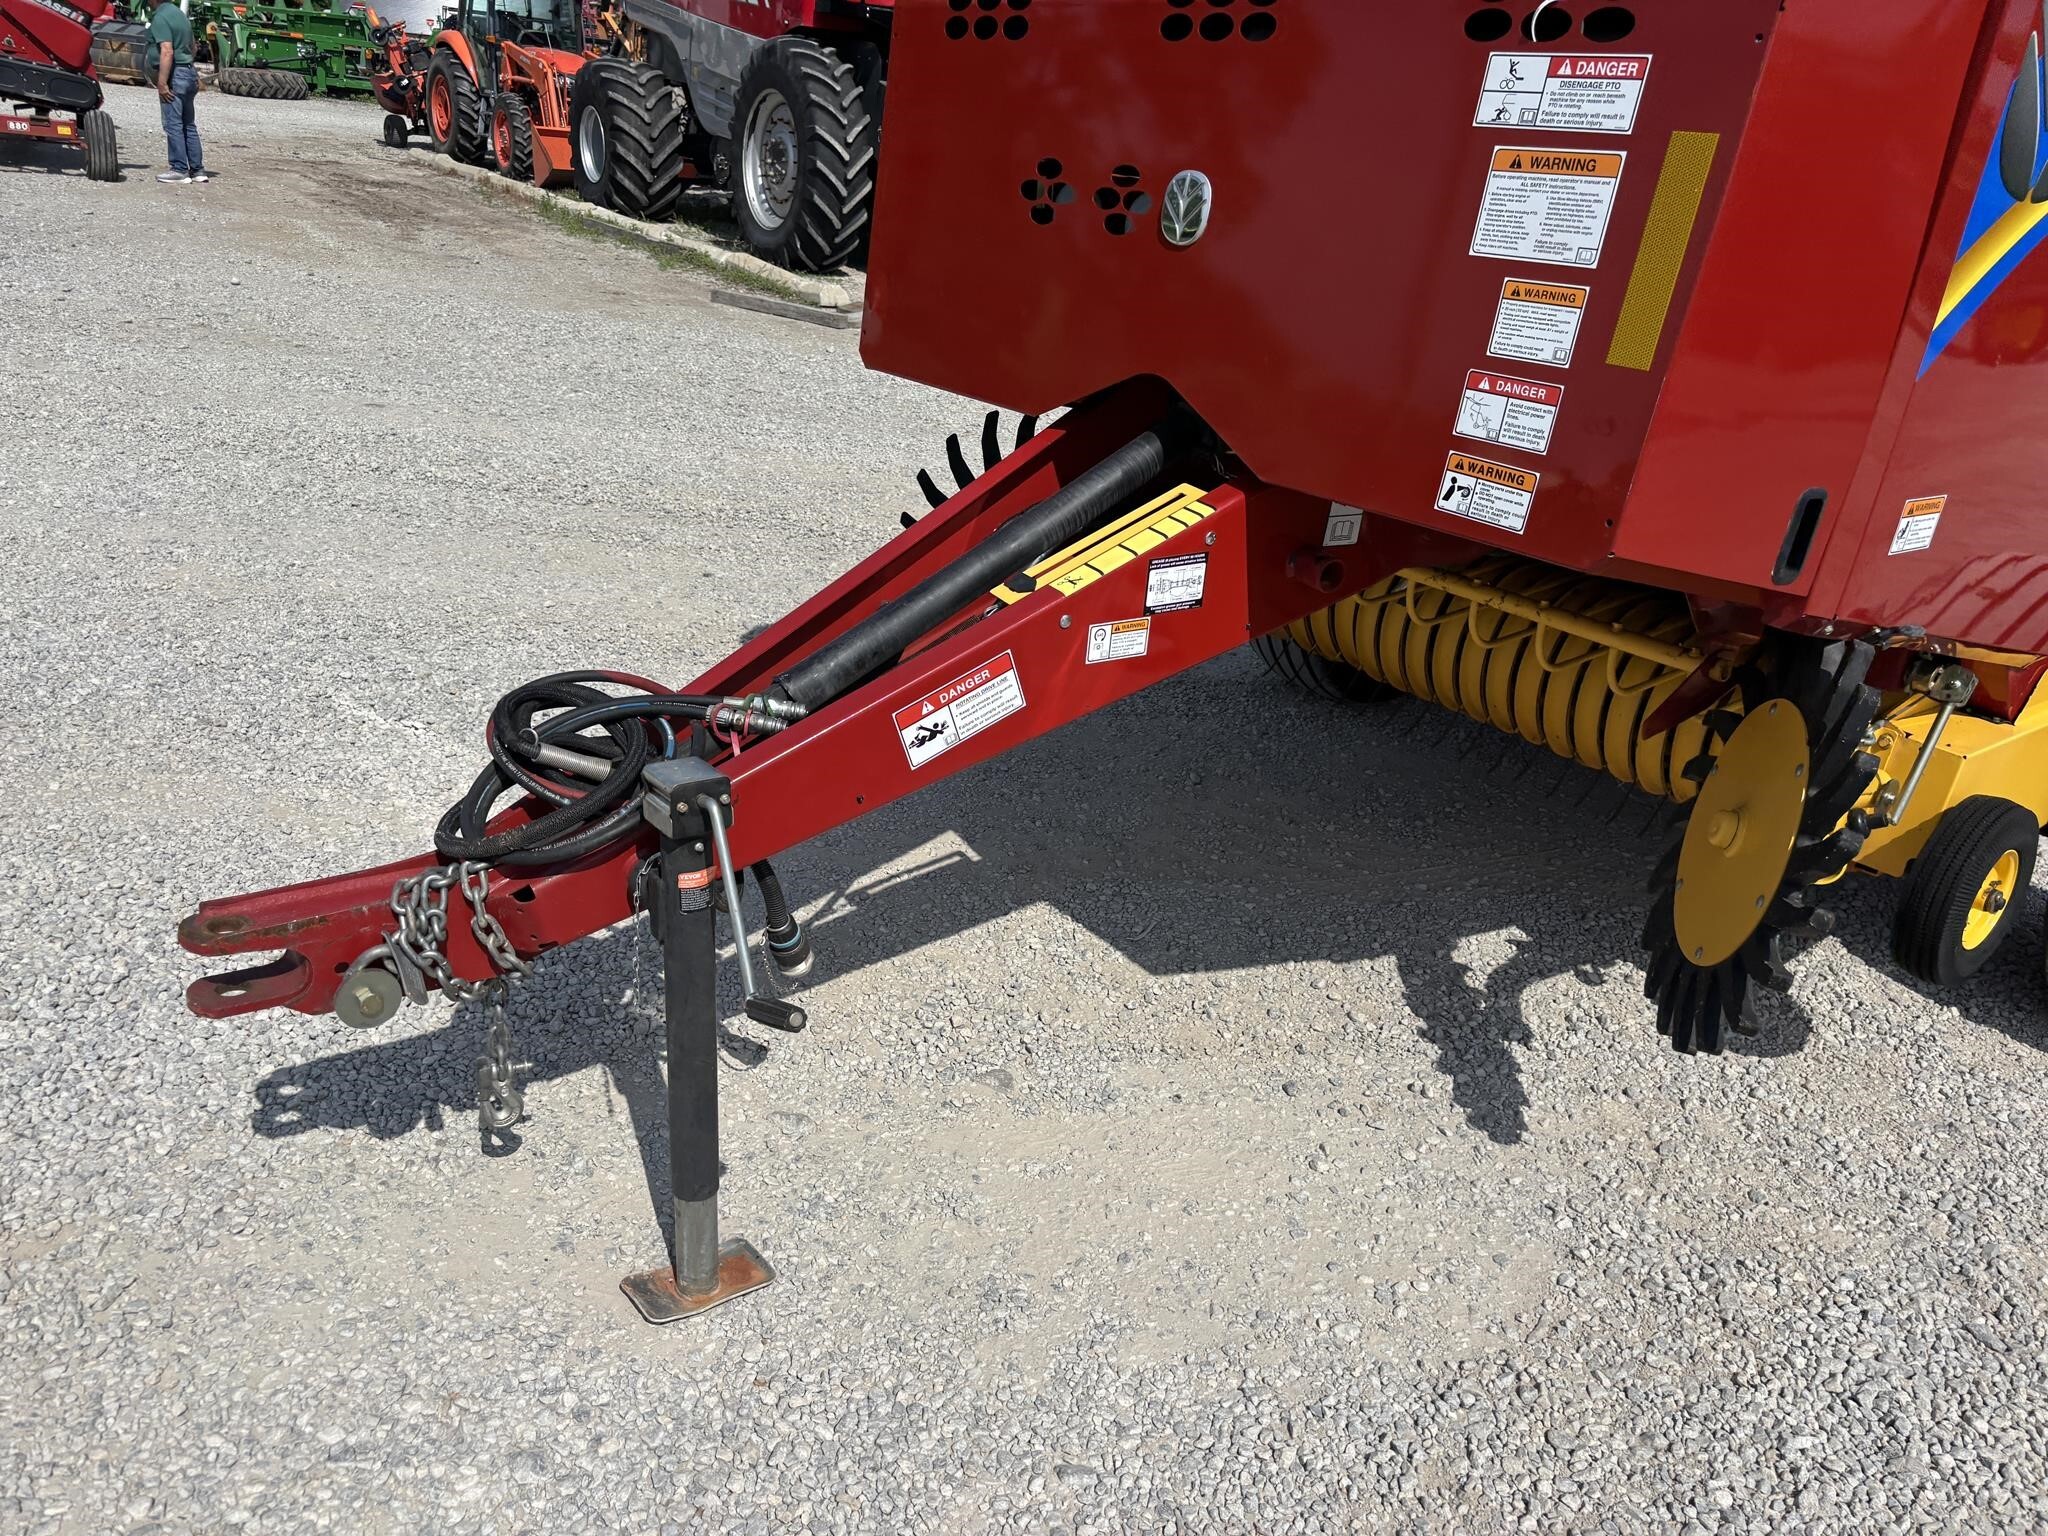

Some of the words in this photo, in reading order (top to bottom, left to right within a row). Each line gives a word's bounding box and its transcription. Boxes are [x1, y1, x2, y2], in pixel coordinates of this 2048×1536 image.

[34, 0, 71, 16] ASE
[1575, 62, 1639, 76] DANGER
[1560, 81, 1604, 89] DISENGAGE
[9, 122, 28, 131] 880
[1529, 156, 1597, 172] WARNING
[1523, 288, 1577, 303] WARNING
[1496, 381, 1546, 399] DANGER
[1505, 421, 1521, 429] Failure
[1527, 426, 1545, 434] comply
[1467, 462, 1525, 486] WARNING
[1473, 501, 1488, 509] Failure
[1495, 507, 1511, 516] comply
[939, 669, 990, 704] DANGER
